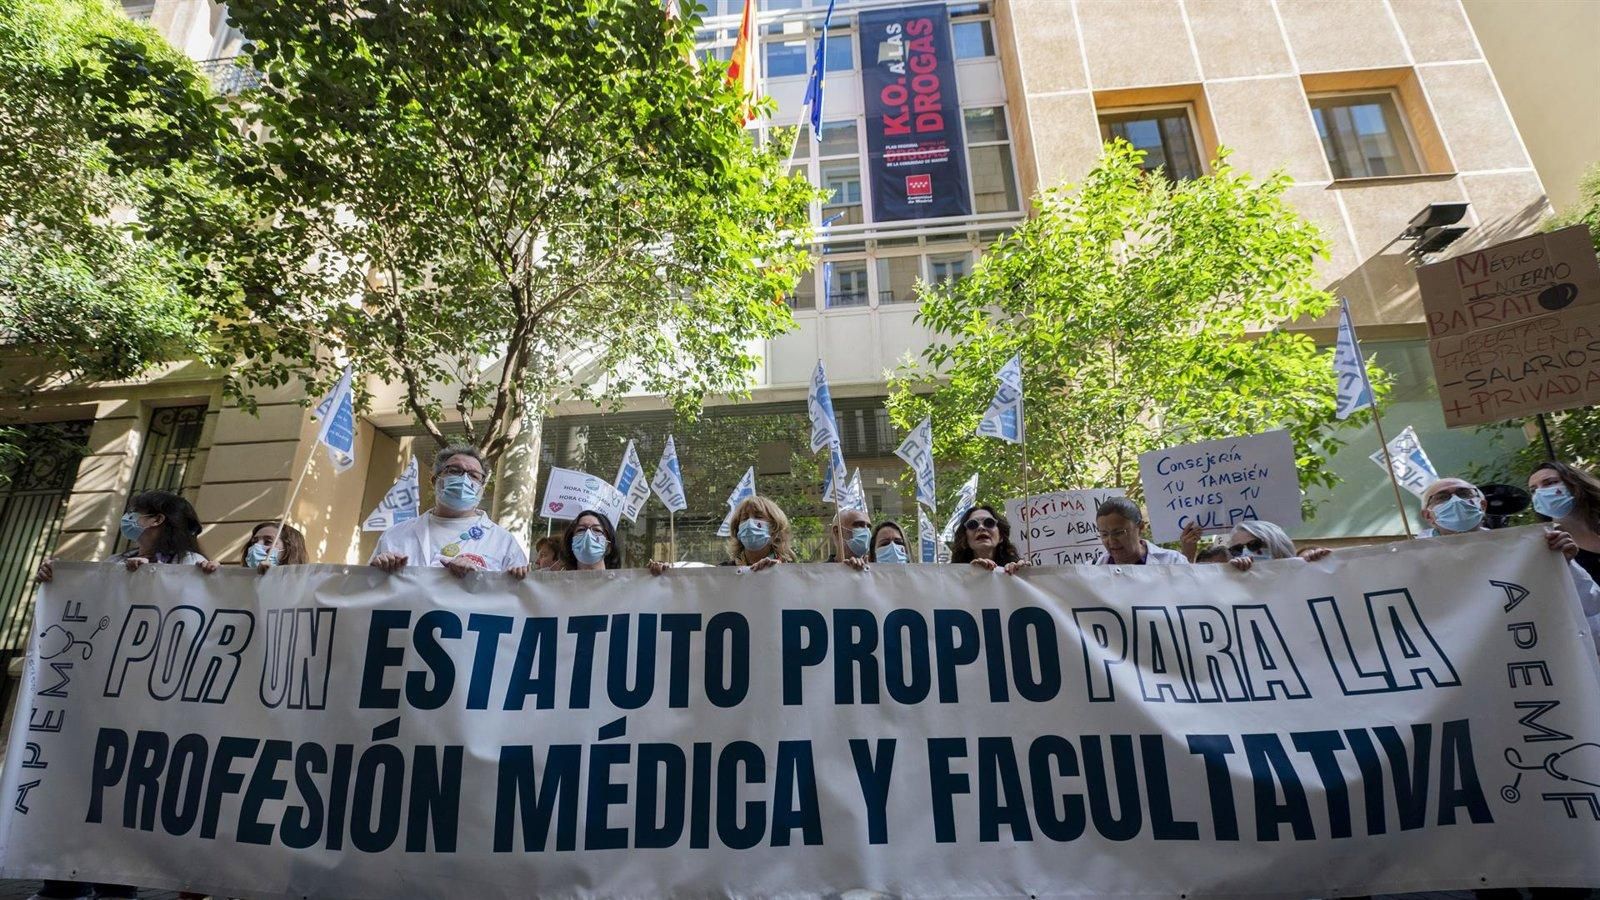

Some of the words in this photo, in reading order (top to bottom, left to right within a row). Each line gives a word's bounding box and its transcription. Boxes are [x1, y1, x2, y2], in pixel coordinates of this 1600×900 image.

[881, 77, 911, 136] K.O.
[906, 18, 944, 133] DROGAS
[1020, 524, 1056, 541] NOS
[1178, 504, 1259, 531] CULPA
[103, 604, 256, 704] POR
[259, 607, 338, 711] UN
[358, 608, 751, 712] ESTATUTO
[781, 606, 1062, 706] PROPIO
[1072, 603, 1312, 704] PARA
[1308, 587, 1462, 696] LA
[85, 715, 465, 854] PROFESIÓN
[493, 715, 823, 854] MÉDICA
[848, 738, 897, 845] Y
[926, 718, 1495, 845] FACULTATIVA
